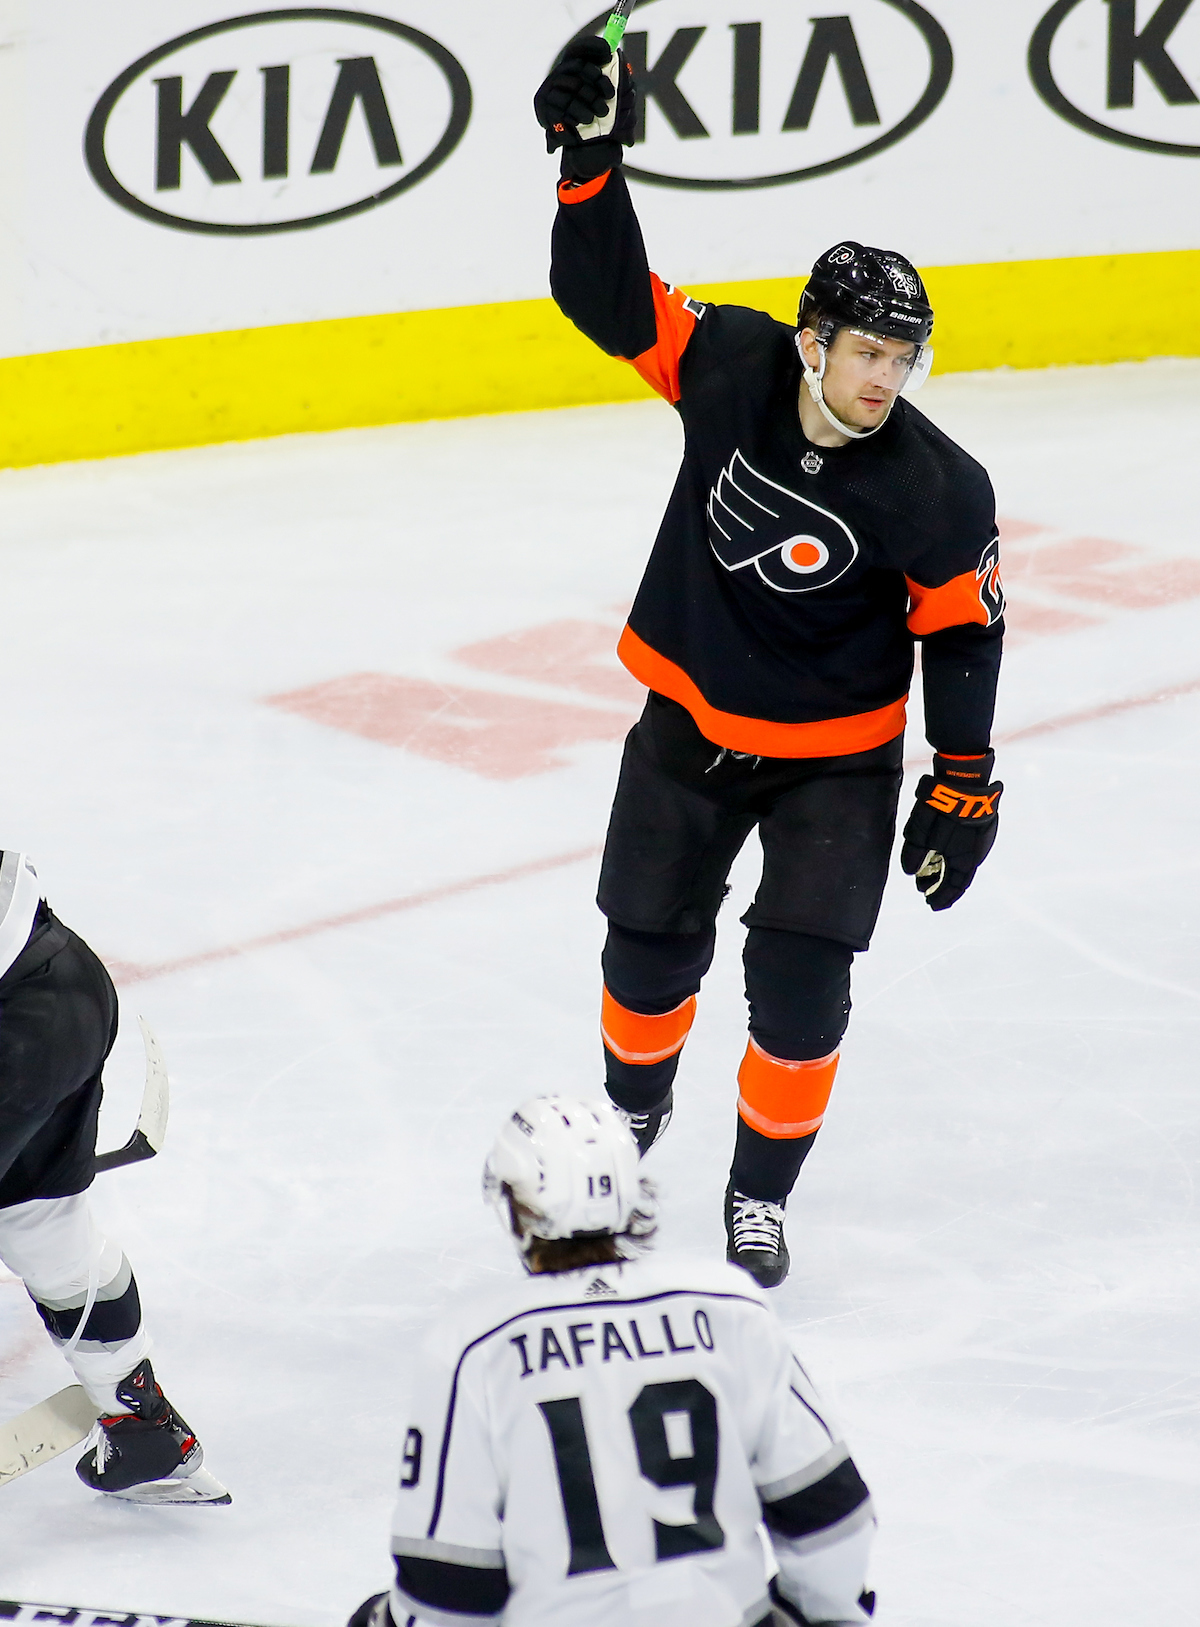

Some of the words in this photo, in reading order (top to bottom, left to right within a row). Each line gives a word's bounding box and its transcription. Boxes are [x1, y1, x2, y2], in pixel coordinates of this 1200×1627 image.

[628, 15, 881, 143] KIA
[152, 55, 405, 193] KIA
[889, 311, 923, 325] BAUER
[925, 784, 1000, 818] STX
[586, 1175, 612, 1198] 19
[510, 1310, 716, 1378] IAFALLO
[400, 1427, 423, 1490] 9
[537, 1378, 727, 1578] 19
